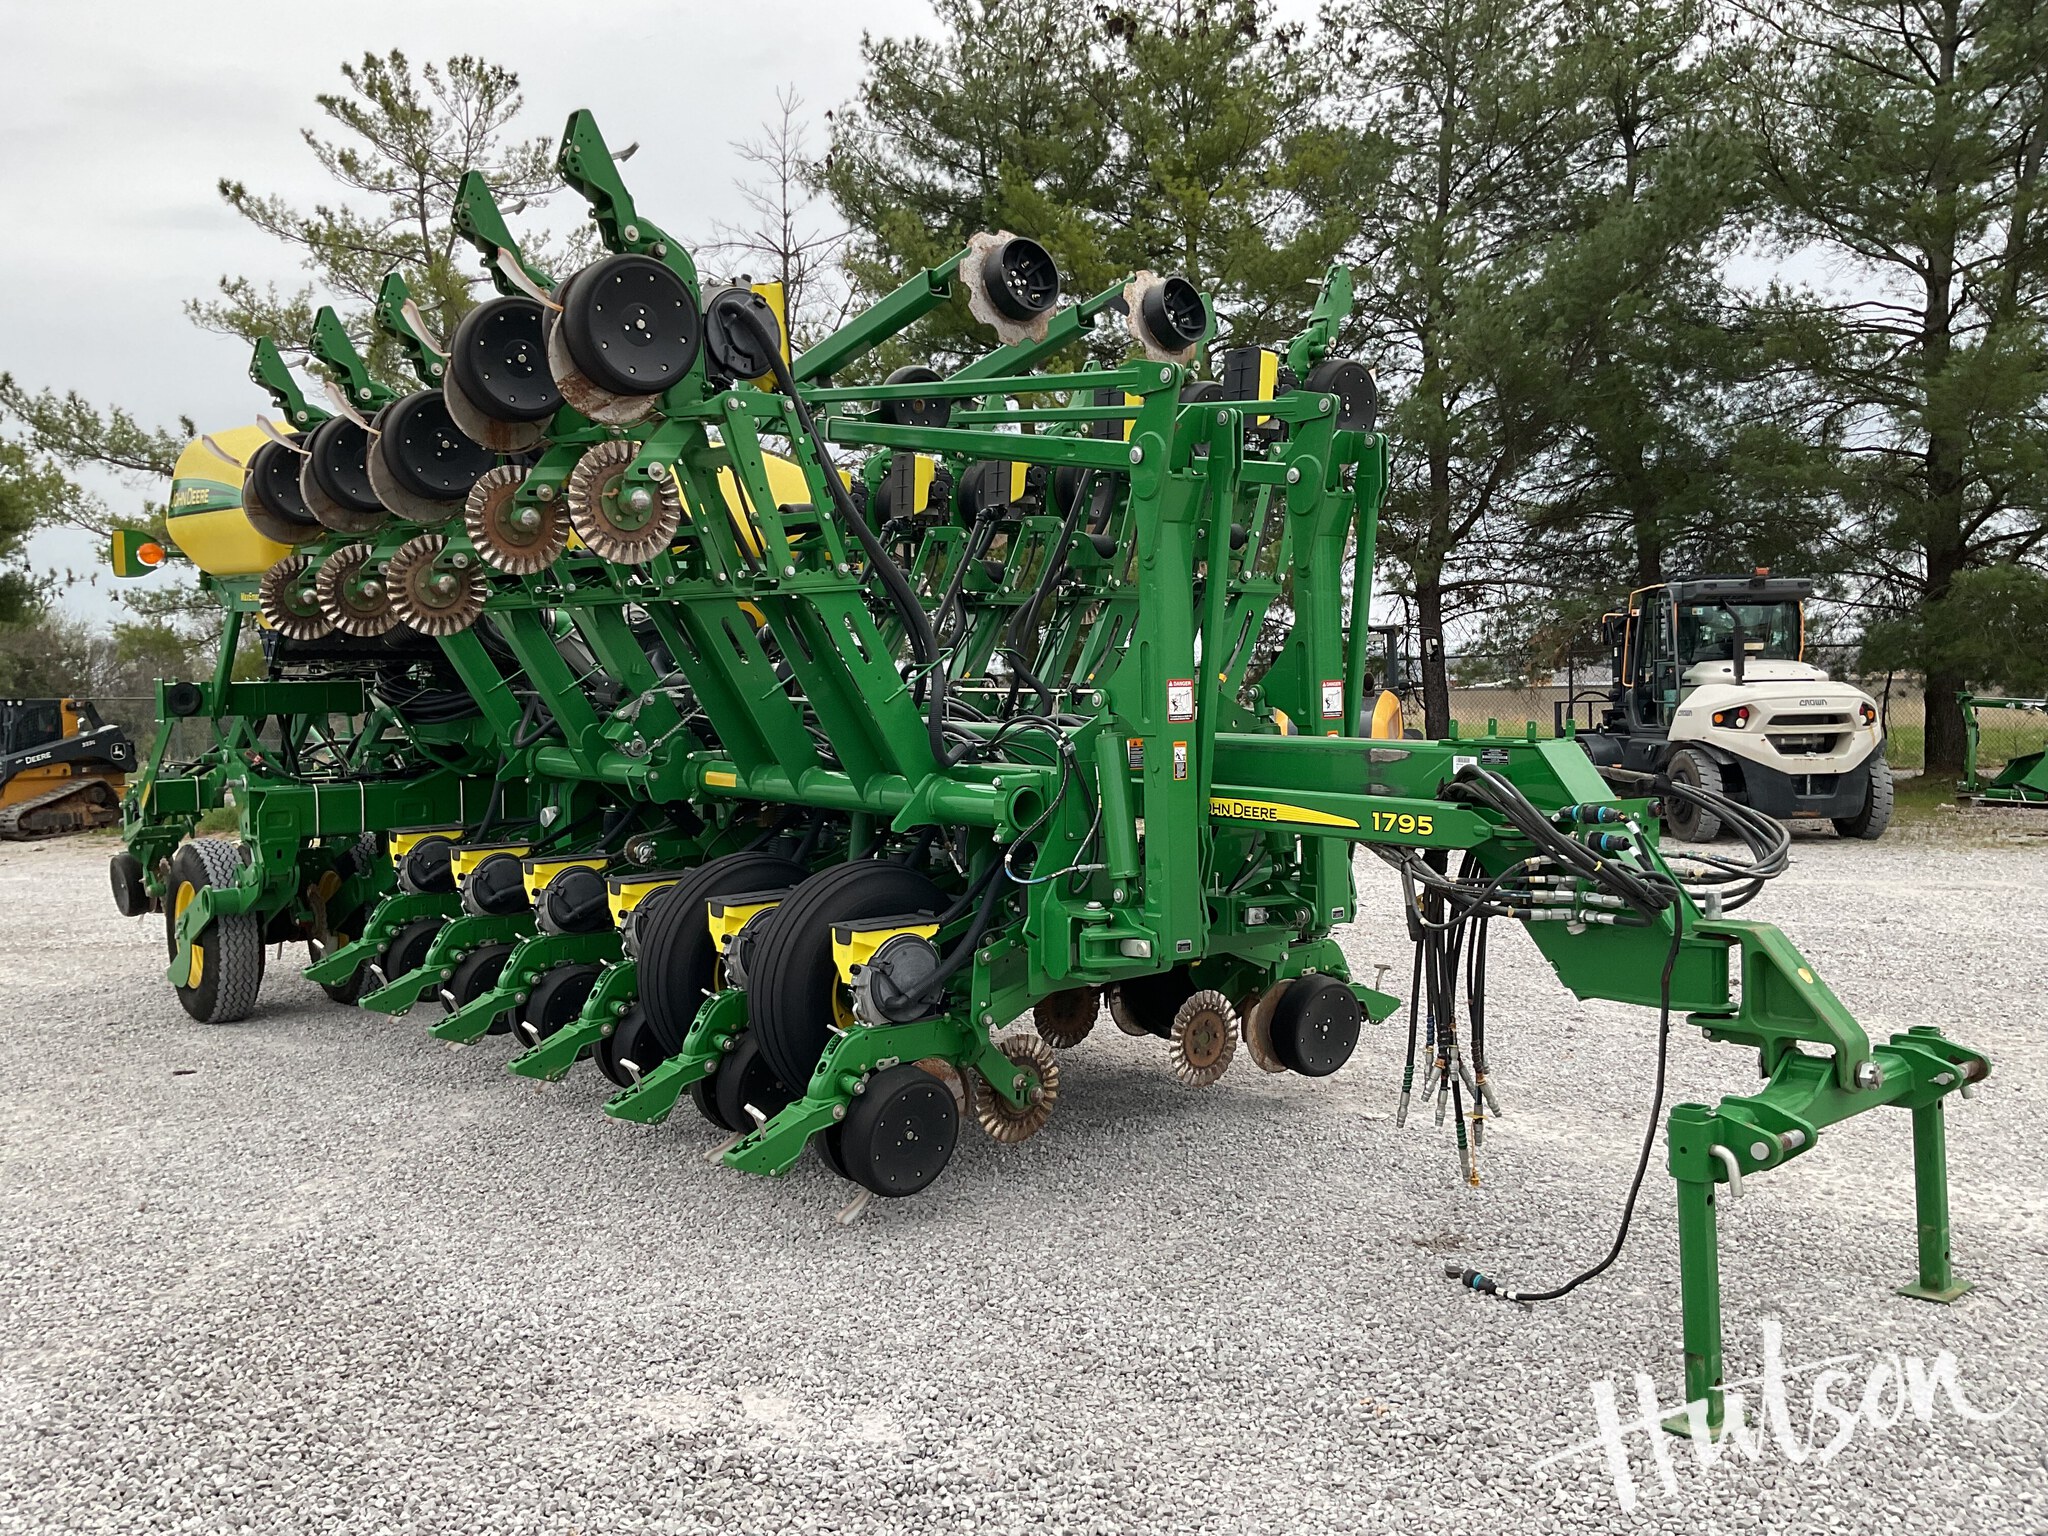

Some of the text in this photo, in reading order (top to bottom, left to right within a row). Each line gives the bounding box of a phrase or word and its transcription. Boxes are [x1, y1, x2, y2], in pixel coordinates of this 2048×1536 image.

[187, 487, 210, 505] DEERE
[25, 751, 52, 765] DEERE
[1233, 802, 1278, 820] DEERE
[1371, 811, 1434, 836] 1795
